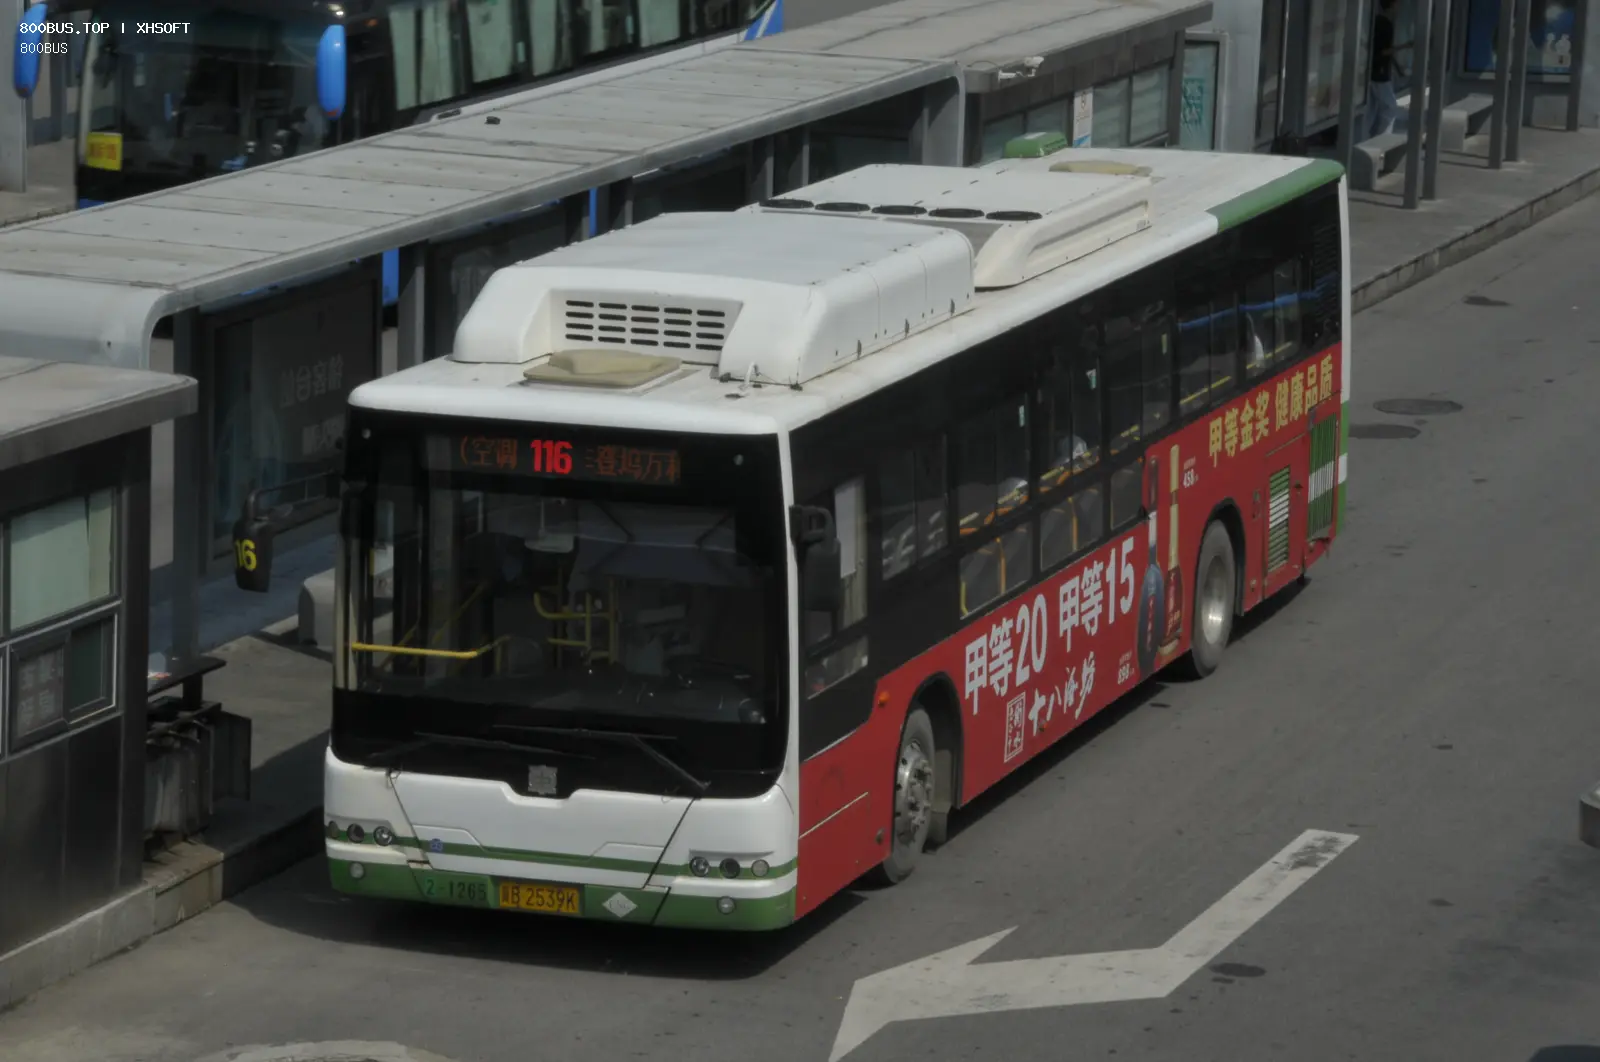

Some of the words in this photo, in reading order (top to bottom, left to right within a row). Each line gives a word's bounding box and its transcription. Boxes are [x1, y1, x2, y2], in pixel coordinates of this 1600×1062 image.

[530, 439, 573, 475] 116
[1209, 389, 1270, 468] 甲等金奖
[1275, 353, 1333, 432] 健康品质
[964, 593, 1047, 716] 甲等20
[1058, 537, 1134, 653] 甲等15
